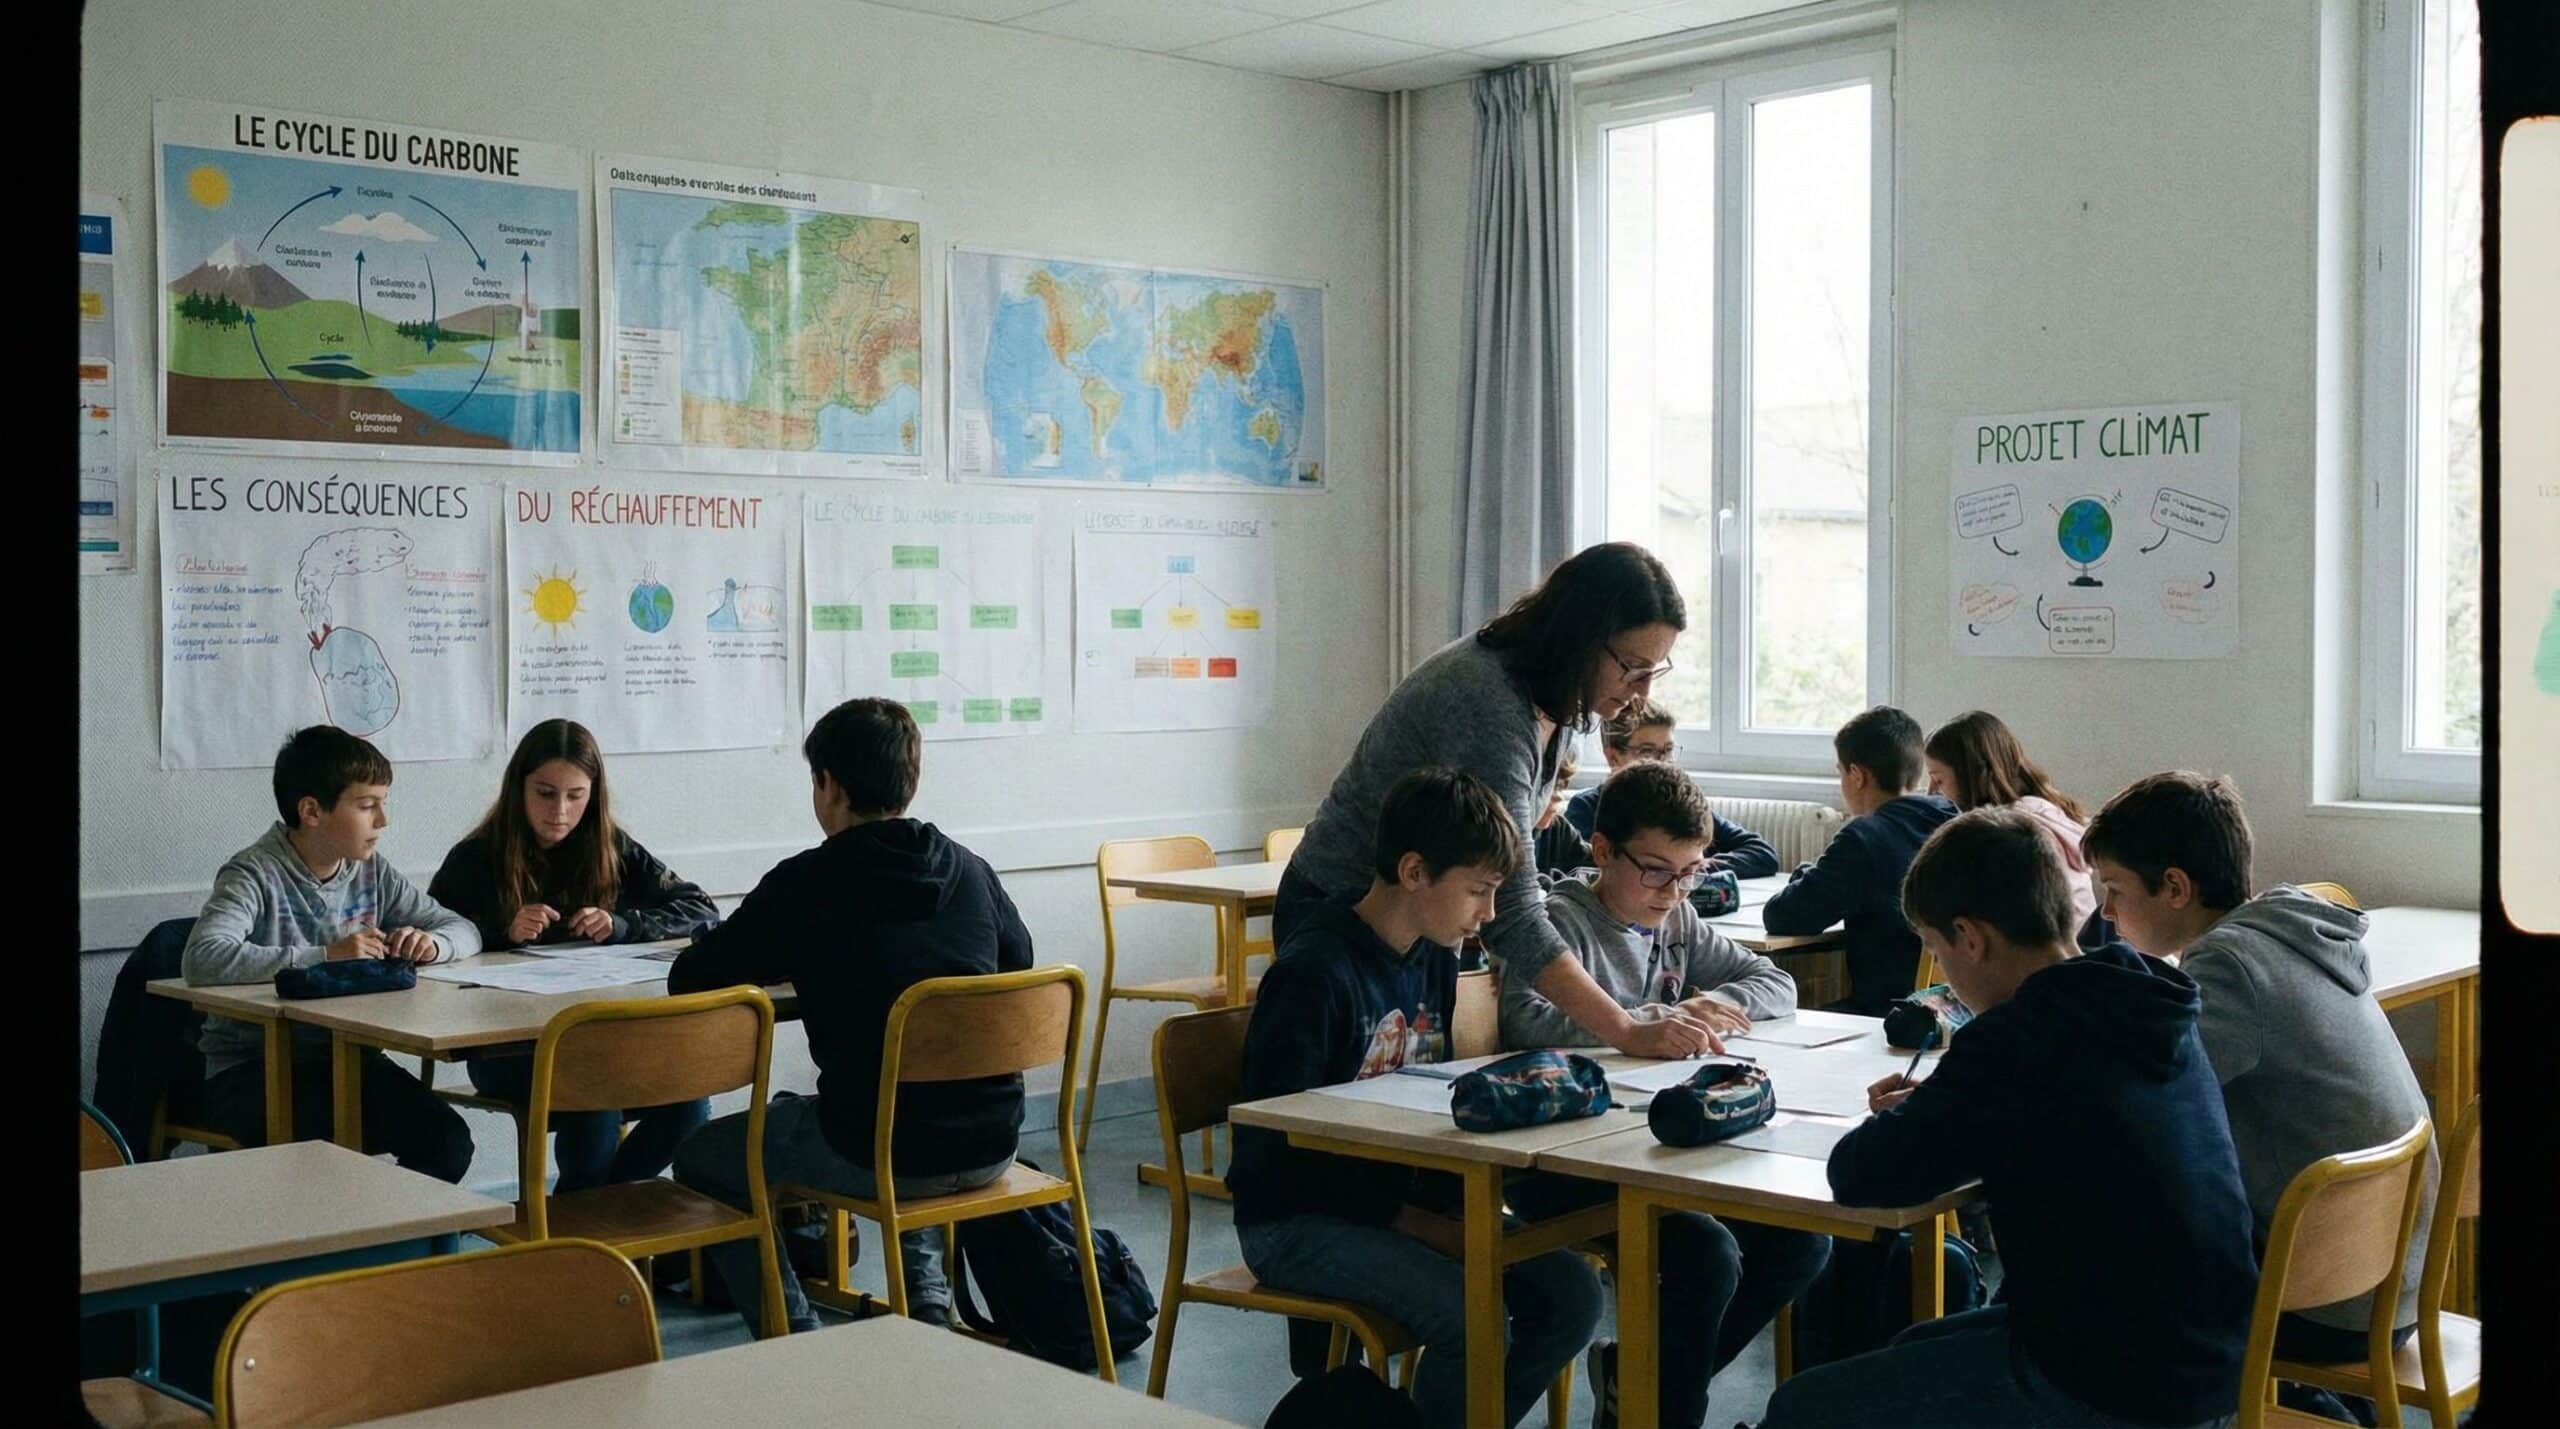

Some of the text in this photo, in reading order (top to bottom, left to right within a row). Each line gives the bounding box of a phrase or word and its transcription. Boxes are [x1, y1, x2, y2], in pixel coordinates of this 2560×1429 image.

[235, 114, 520, 177] LE CYCLE DU CARBONE
[1976, 418, 2087, 465] PROJET
[171, 473, 469, 519] LES CONSÉQUENCES
[516, 484, 763, 529] DU RÉCHAUFFEMENT
